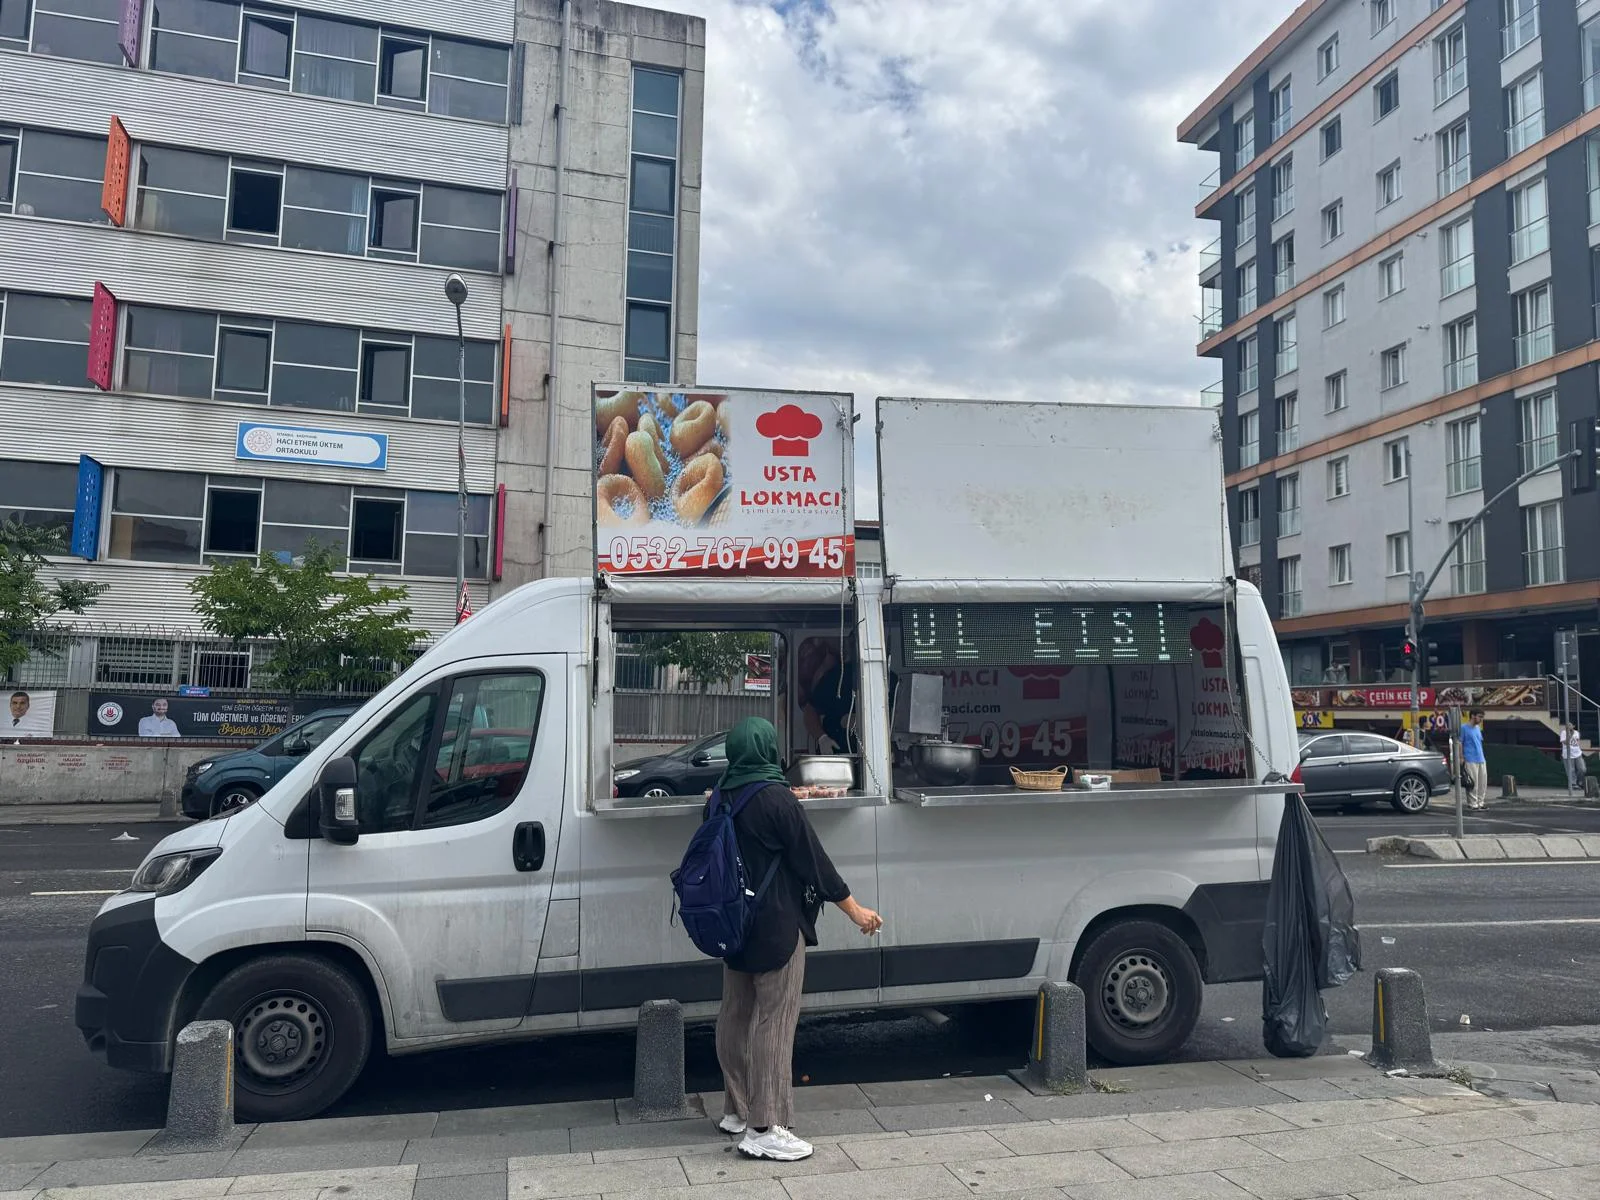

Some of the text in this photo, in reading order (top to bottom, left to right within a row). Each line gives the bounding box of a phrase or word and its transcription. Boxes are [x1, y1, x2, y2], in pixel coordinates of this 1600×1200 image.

[275, 446, 318, 456] ORTAOKULU
[294, 439, 318, 447] ETHEM
[319, 440, 344, 449] ÜKTEM
[763, 465, 817, 483] USTA
[740, 490, 840, 507] LOKMACI
[610, 535, 844, 570] 0532 767 99 45
[1202, 676, 1229, 693] USTA
[1369, 690, 1395, 706] ÇETİN
[193, 711, 209, 722] TÜM
[210, 711, 249, 723] ÖĞRETMEN
[250, 715, 259, 723] ve
[1031, 720, 1072, 757] 45
